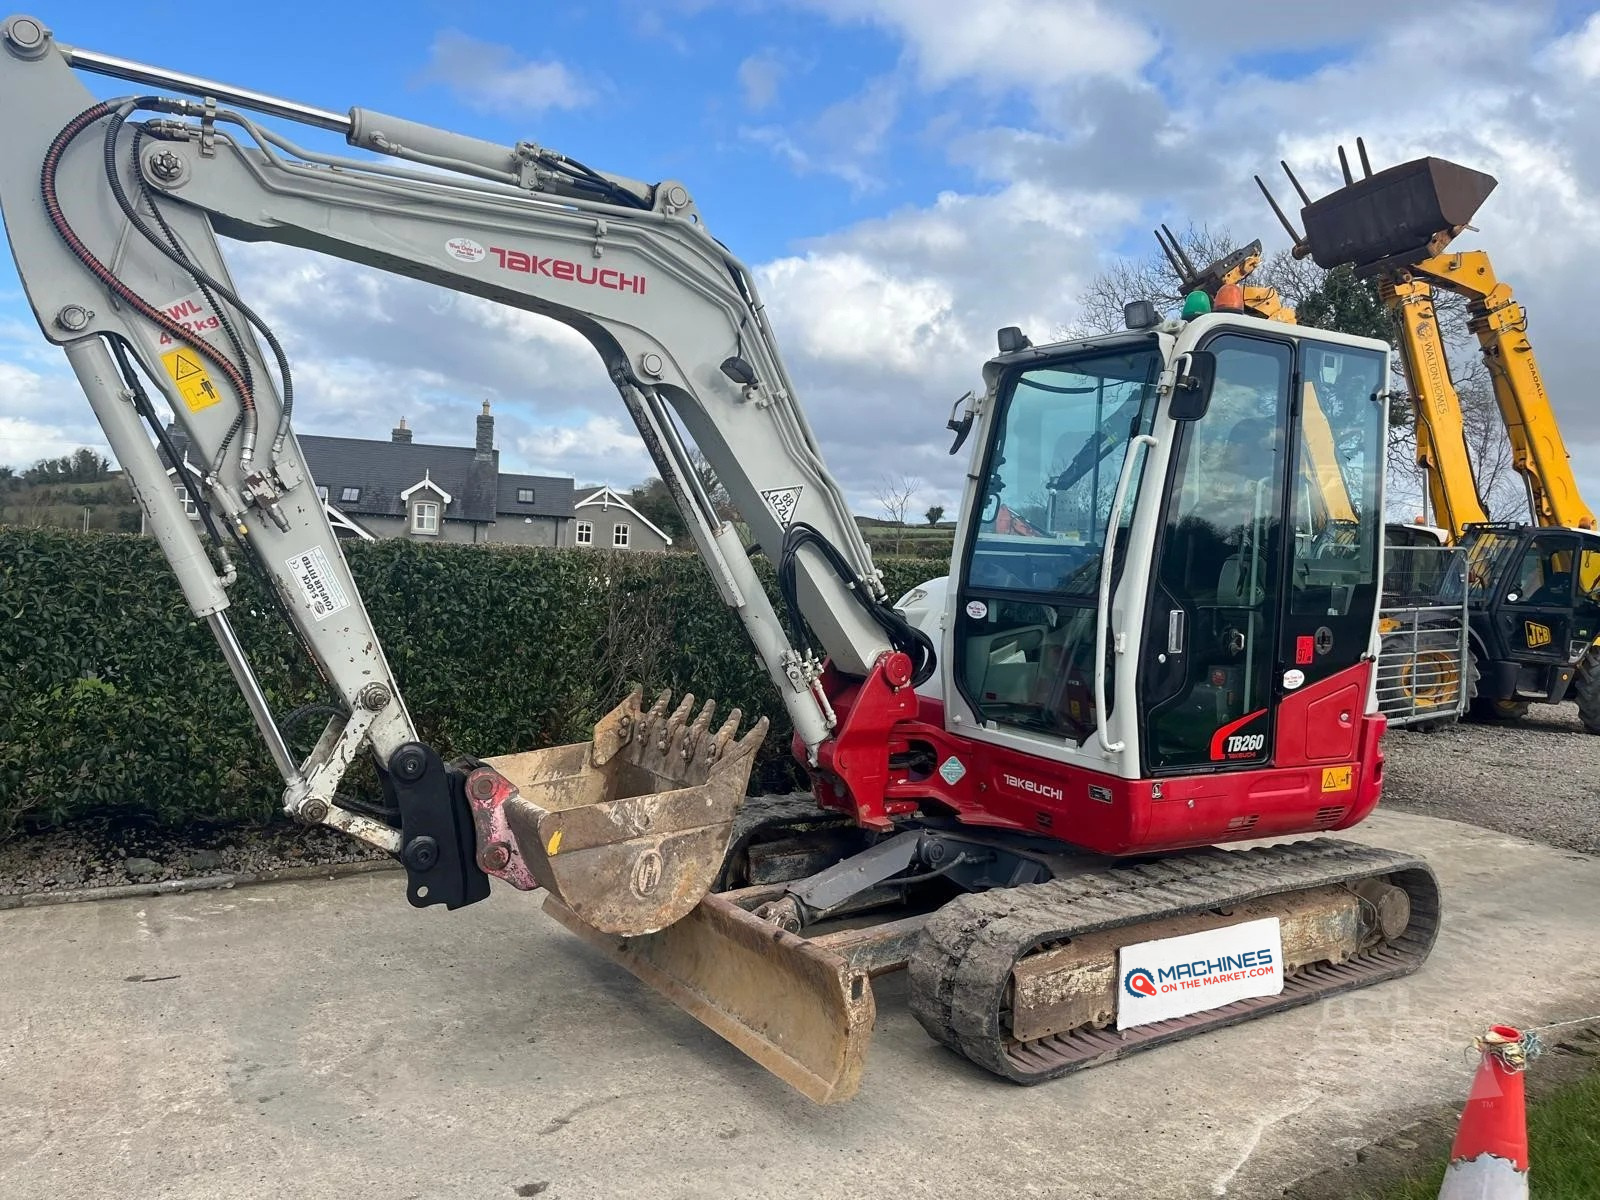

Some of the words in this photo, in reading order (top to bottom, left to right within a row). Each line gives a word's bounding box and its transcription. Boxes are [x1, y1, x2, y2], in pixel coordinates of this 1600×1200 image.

[489, 247, 646, 295] TAKEUCHI
[162, 300, 203, 320] WL
[1424, 341, 1441, 381] WALTON
[1435, 382, 1448, 415] HOMES
[1527, 358, 1544, 399] LOADALL
[782, 492, 794, 507] 88
[301, 556, 319, 580] FITTED
[1529, 624, 1549, 645] JCB
[1228, 734, 1264, 752] TB260
[1003, 773, 1063, 801] TAKEUCHI
[1157, 948, 1273, 983] MACHINES
[1160, 983, 1177, 993] ON
[1179, 978, 1201, 990] THE
[1203, 965, 1274, 986] MARKET.COM
